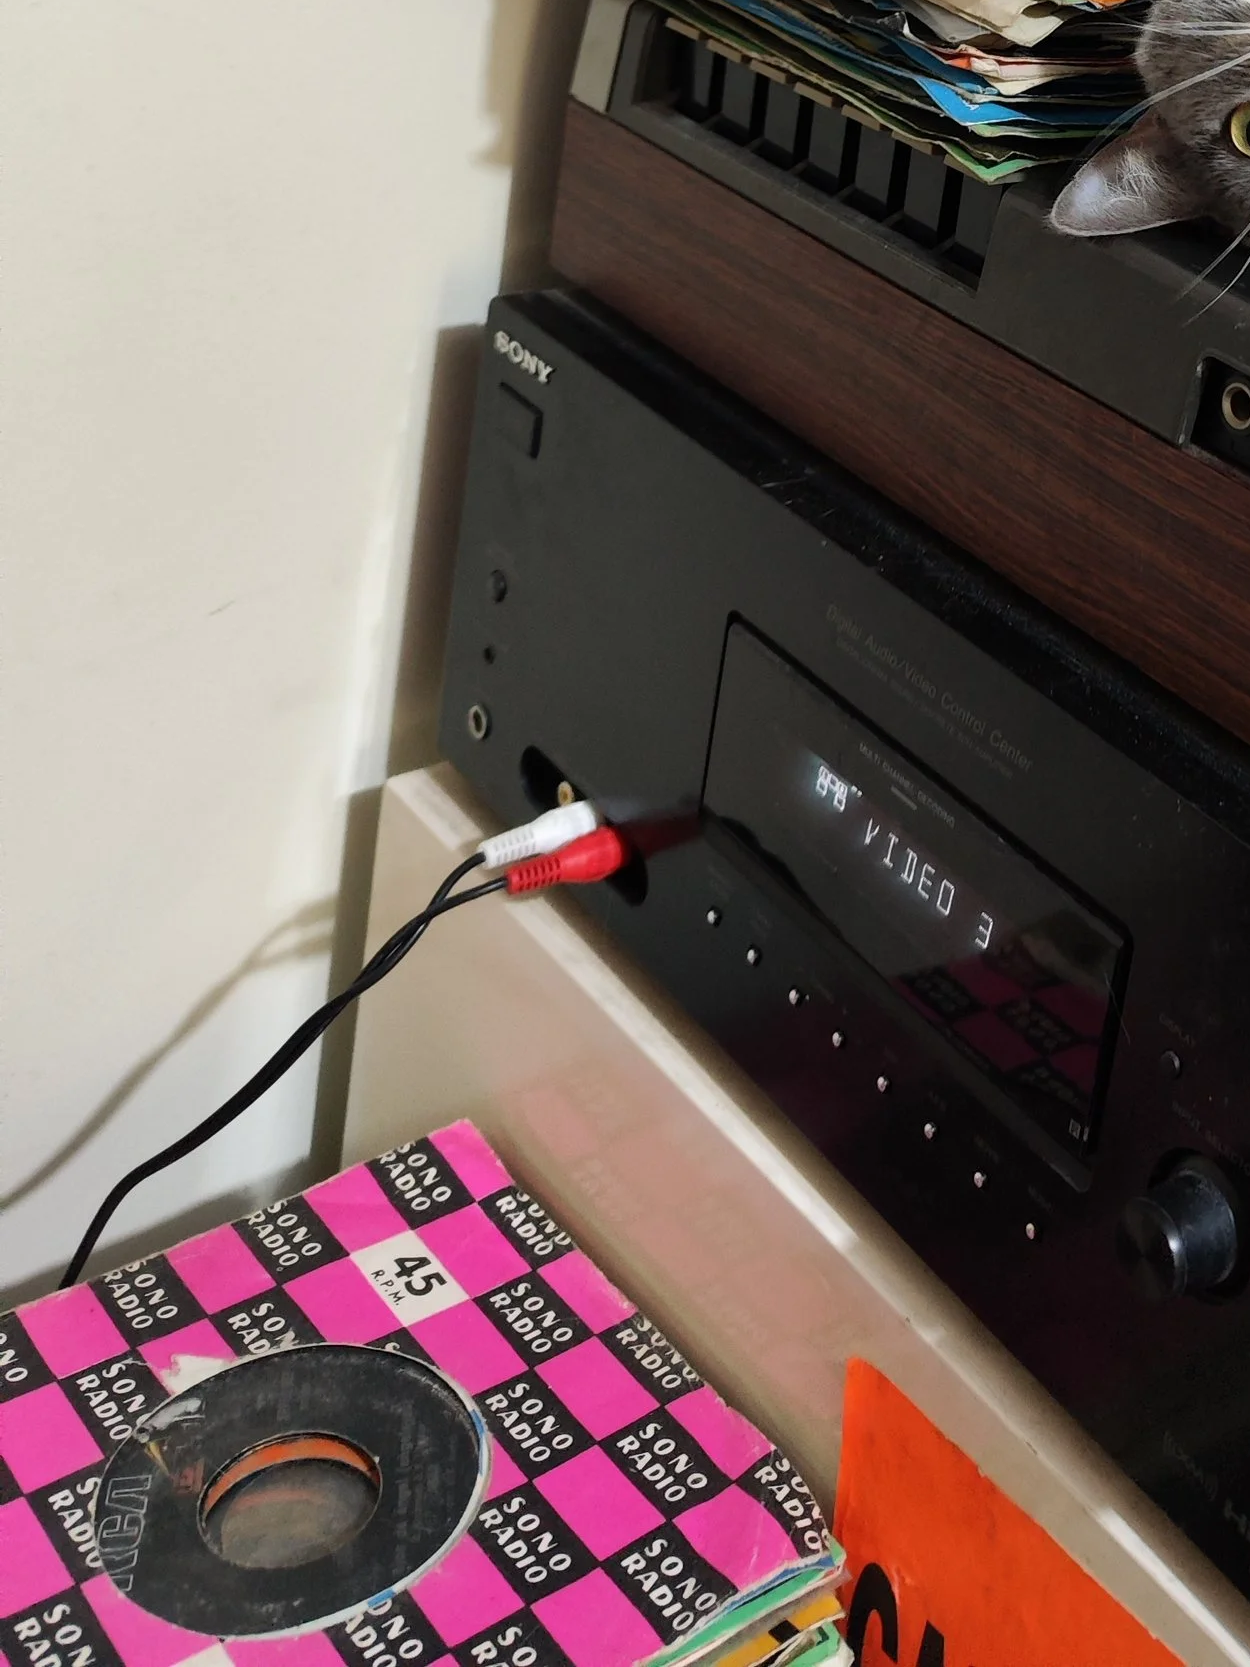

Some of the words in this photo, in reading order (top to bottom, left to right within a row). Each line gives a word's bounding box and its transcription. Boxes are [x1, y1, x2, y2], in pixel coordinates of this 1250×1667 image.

[494, 330, 553, 383] SONY
[825, 603, 862, 641] Digital
[865, 634, 937, 699] Audio/Video
[940, 691, 987, 737] Control
[989, 728, 1034, 774] Center
[863, 817, 956, 916] VIDEO
[975, 911, 994, 949] 3
[379, 1151, 432, 1211] RADIO
[248, 1210, 300, 1266] RADIO
[267, 1199, 322, 1256] SONO
[495, 1195, 554, 1256] RADIO
[104, 1269, 154, 1329] RADIO
[371, 1269, 407, 1306] R.P.M.
[393, 1256, 448, 1297] 45
[227, 1312, 271, 1356] RAD
[251, 1302, 301, 1352] SON
[489, 1292, 552, 1354] RADIO
[511, 1282, 573, 1342] SONO
[616, 1328, 682, 1390] RADIO
[76, 1373, 133, 1441] RADIO
[485, 1393, 551, 1462] RADIO
[508, 1383, 573, 1450] SONO
[616, 1434, 686, 1502] RADIO
[639, 1422, 708, 1490] SONO
[503, 1496, 572, 1572] SONO
[753, 1465, 822, 1551] RADIO
[478, 1507, 548, 1584] RADIO
[644, 1538, 718, 1612] SONO
[620, 1552, 694, 1631] RADIO
[13, 1616, 62, 1667] RAD
[43, 1603, 97, 1667] SON
[344, 1614, 397, 1667] ADIO
[497, 1626, 538, 1667] SO
